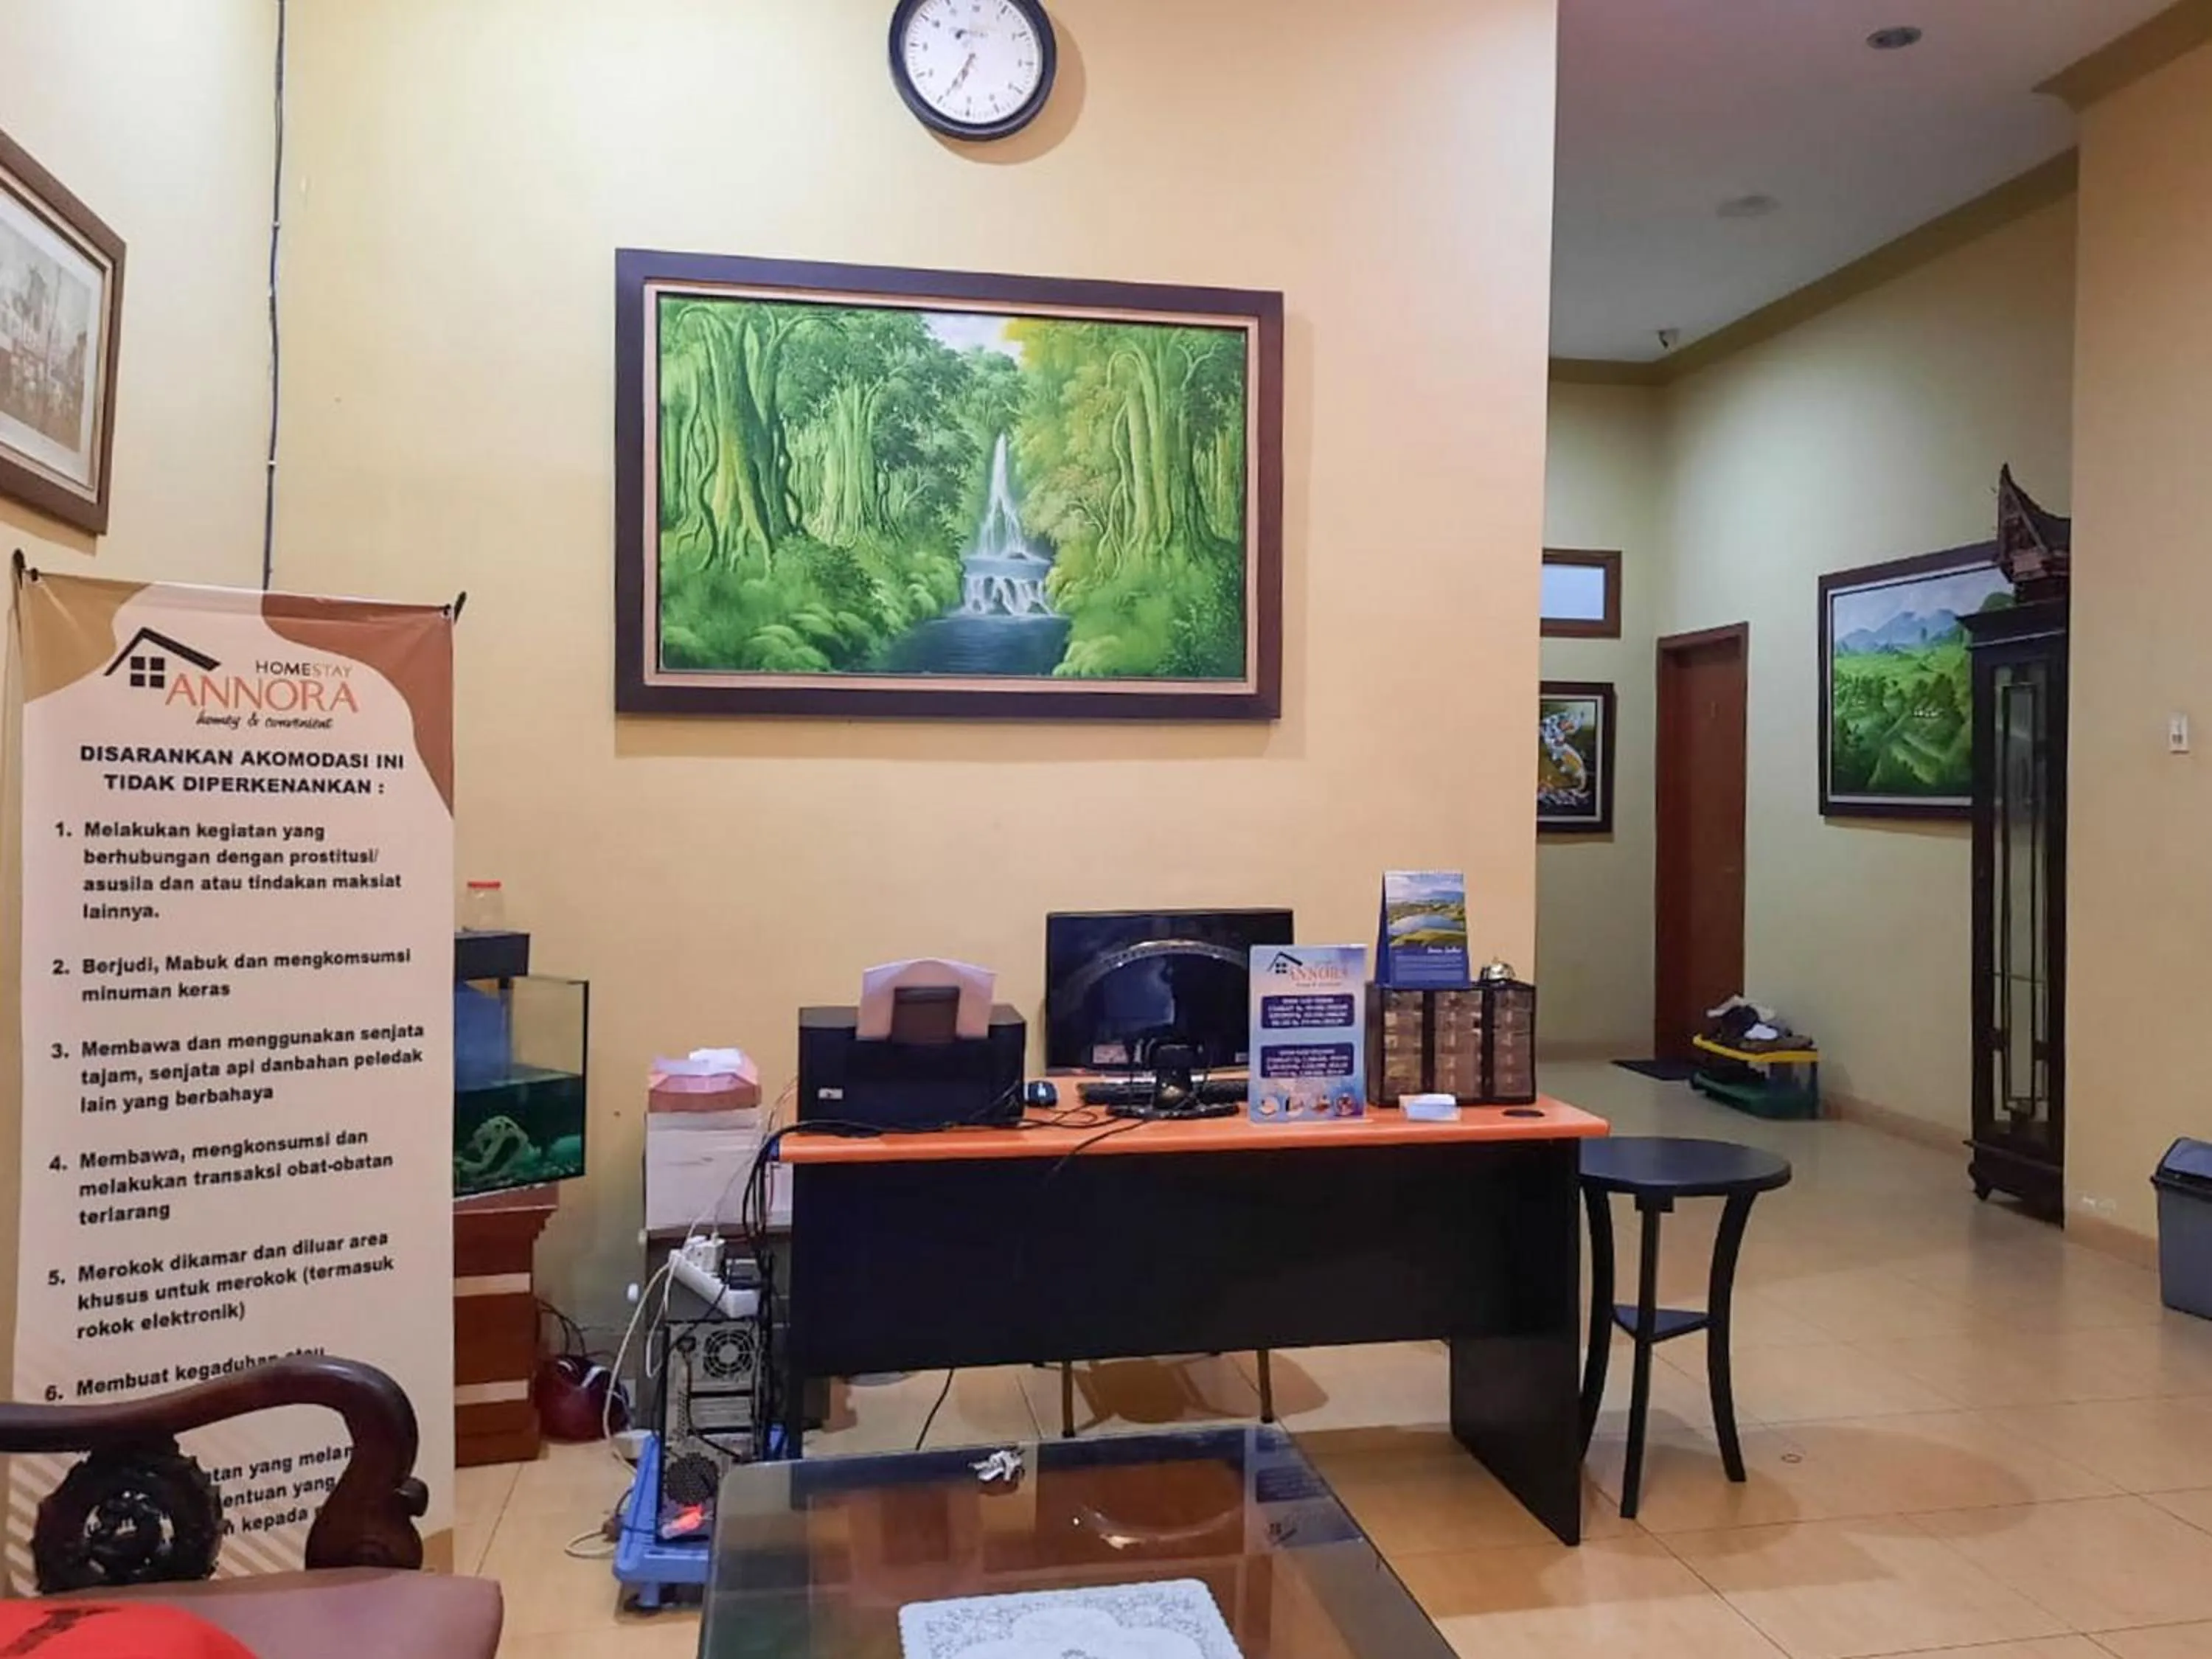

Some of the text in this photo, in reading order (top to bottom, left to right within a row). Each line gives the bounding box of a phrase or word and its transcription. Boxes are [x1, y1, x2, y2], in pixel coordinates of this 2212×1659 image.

[255, 660, 352, 678] HOMESTAY
[164, 672, 359, 714] ANNORA
[81, 745, 403, 769] DISARANKAN AKOMODASI INI
[103, 773, 175, 791] TIDAK
[183, 776, 371, 794] DIPERKENANKAN
[55, 821, 325, 842] 1. Melakukan kegiatan yang
[83, 849, 210, 868] berhubungan
[216, 849, 284, 868] dengan
[83, 873, 402, 892] asusila dan atau tindakan maksiat
[83, 903, 160, 922] lainnya.
[52, 947, 411, 977] 2. Berjudi, Mabuk dan mengkomsumsi
[82, 982, 231, 1002] minuman keras
[51, 1024, 424, 1060] 3. Membawa dan menggunakan senjata
[81, 1048, 422, 1088] tajam, senjata api danbahan peledak
[80, 1087, 274, 1114] lain yang berbahaya
[49, 1130, 368, 1171] 4. Membawa, mengkonsumsi dan
[79, 1155, 394, 1197] melakukan transaksi obat-obatan
[79, 1204, 170, 1225] terlarang
[48, 1233, 389, 1286] 5. Merokok dikamar dan diluar area
[77, 1255, 394, 1311] khusus untuk merokok (termasuk
[77, 1301, 246, 1339] rokok elektronik)
[44, 1385, 64, 1402] 6.
[76, 1368, 169, 1397] Membuat
[248, 1457, 293, 1480] yang
[293, 1476, 337, 1501] yang
[241, 1509, 308, 1533] kepada
